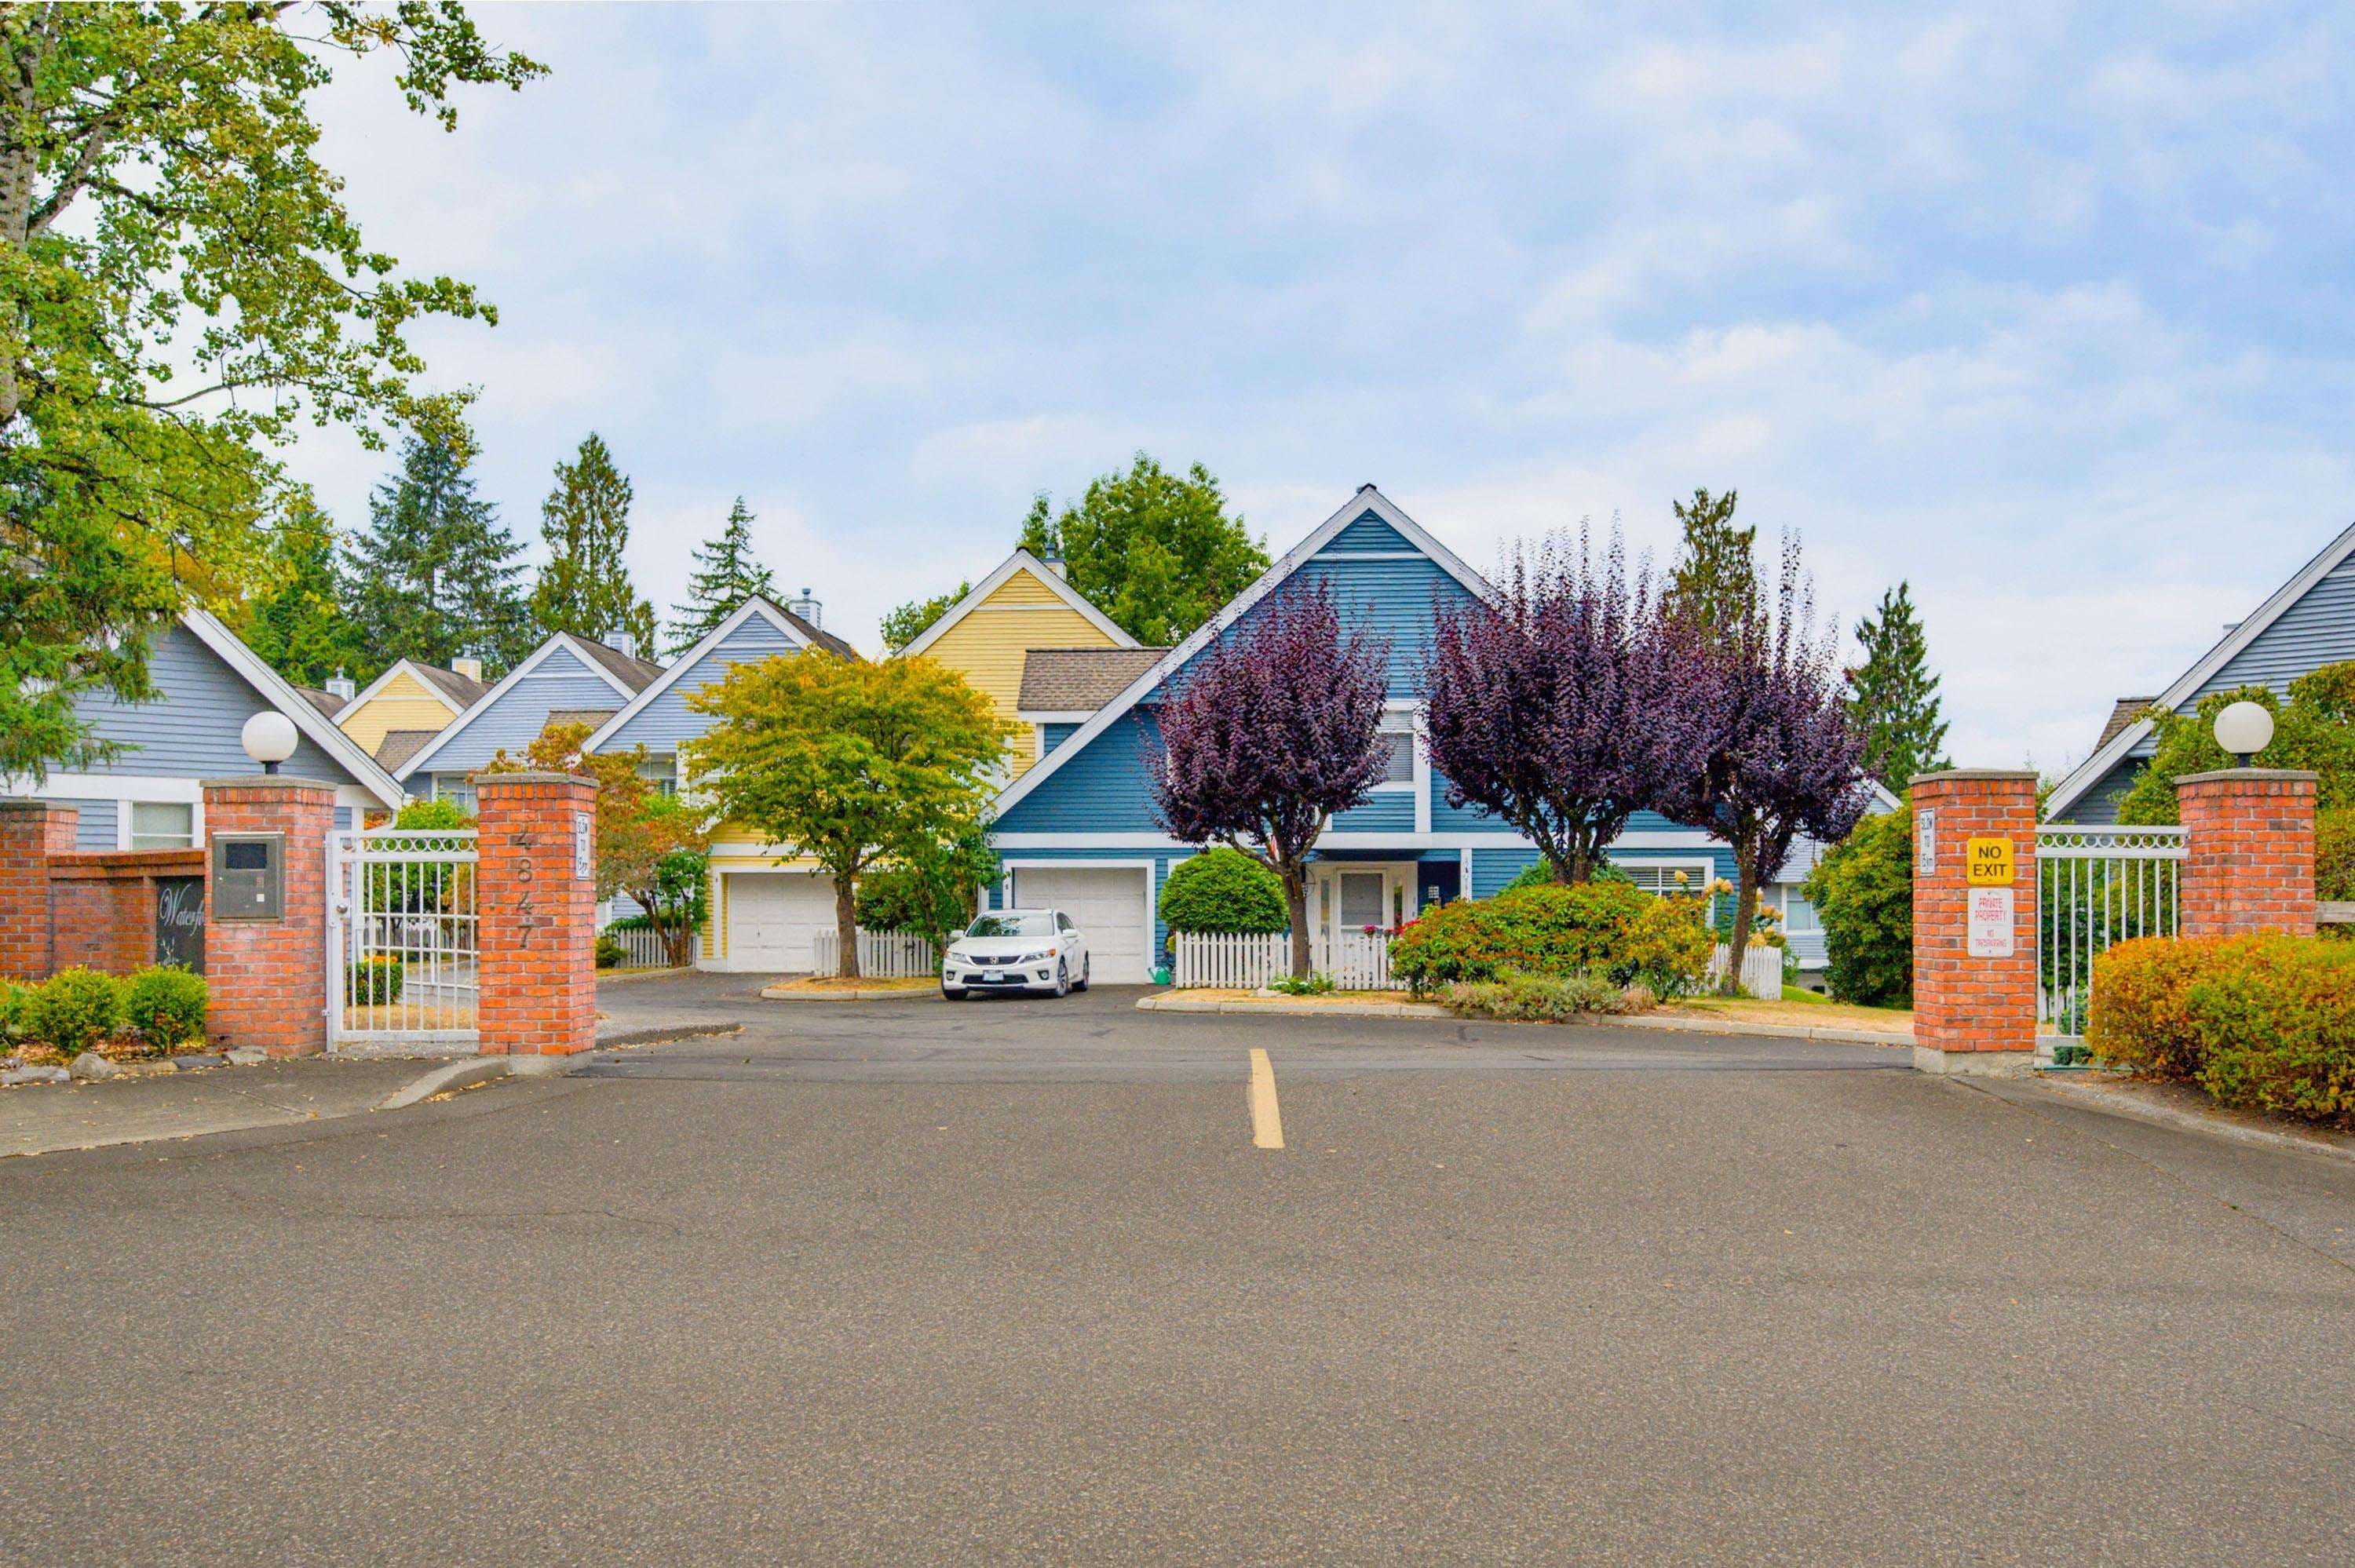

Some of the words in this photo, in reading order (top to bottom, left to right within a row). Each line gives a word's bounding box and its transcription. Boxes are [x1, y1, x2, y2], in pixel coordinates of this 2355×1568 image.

[1978, 845, 2002, 859] NO
[1973, 863, 2007, 877] EXIT
[515, 823, 534, 948] 4847
[1978, 897, 2003, 909] PRIVATE
[1975, 910, 2007, 921] PROPERTY
